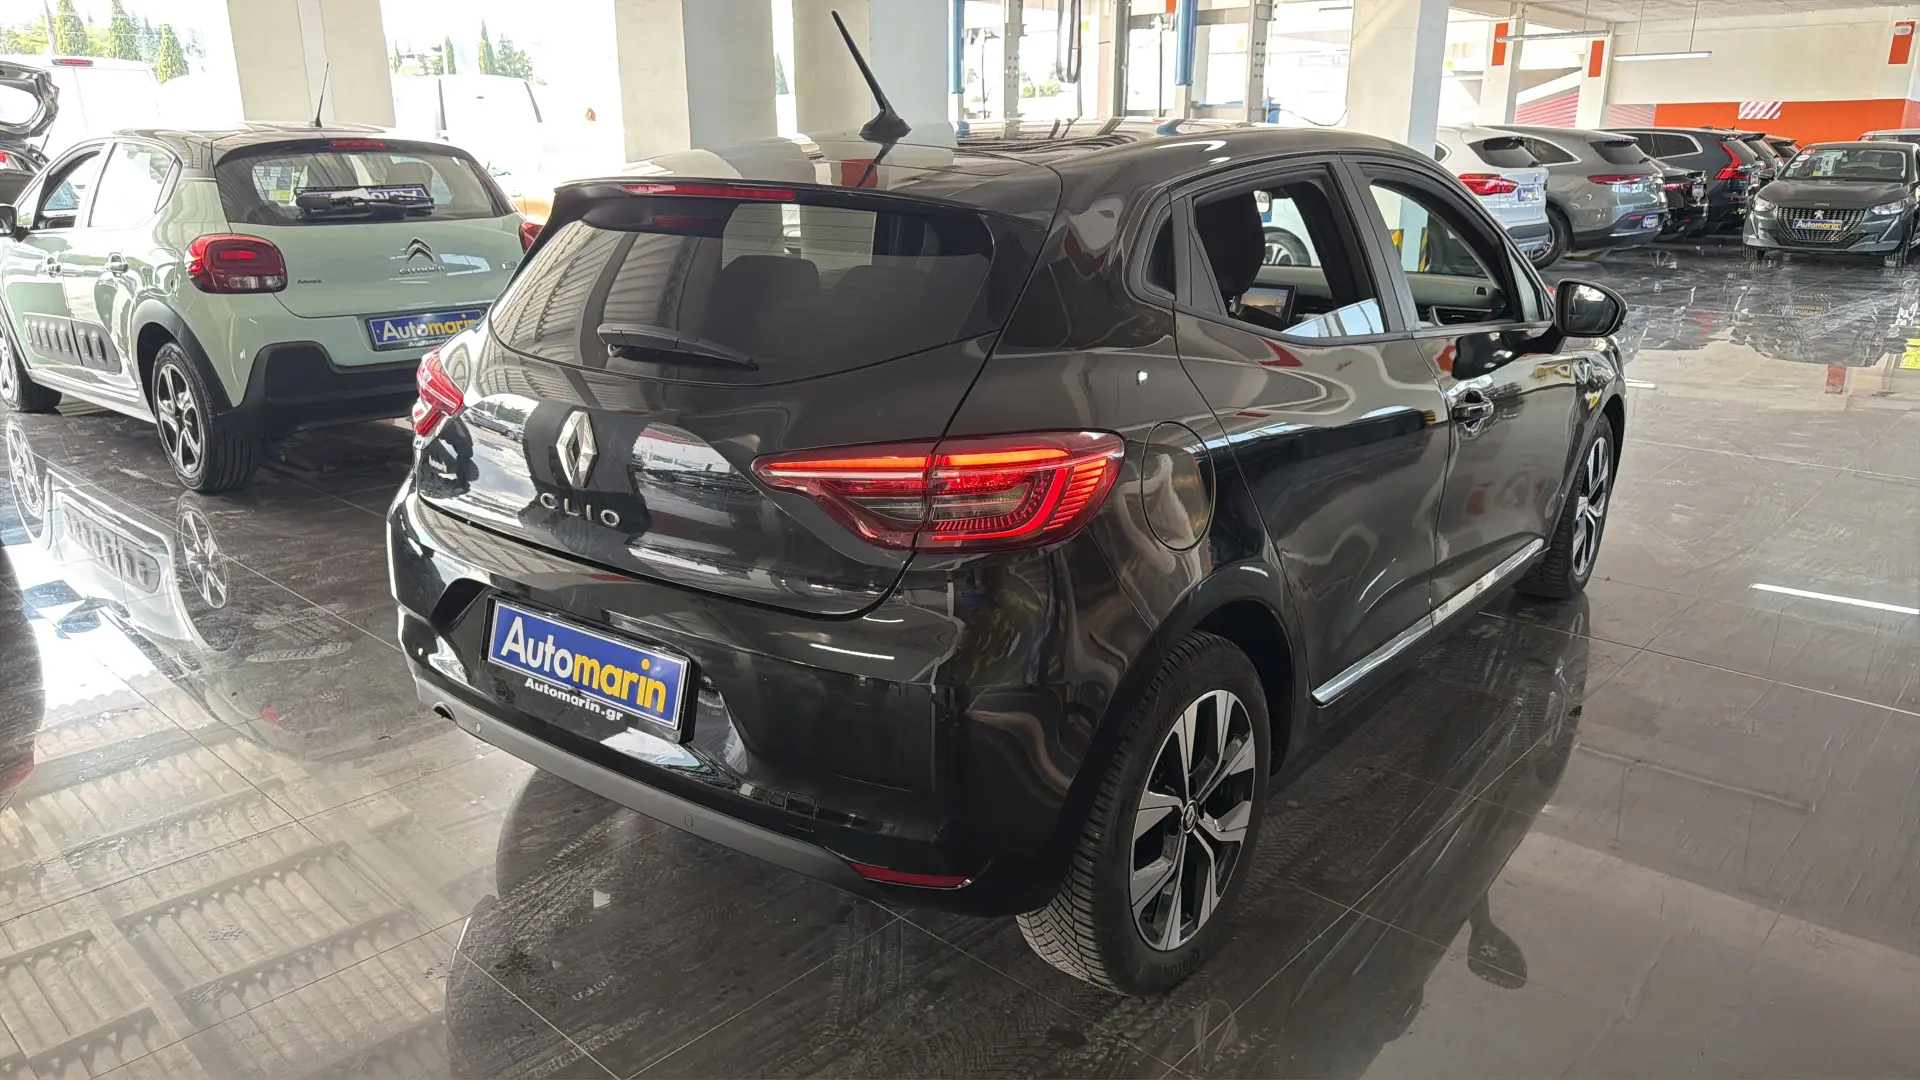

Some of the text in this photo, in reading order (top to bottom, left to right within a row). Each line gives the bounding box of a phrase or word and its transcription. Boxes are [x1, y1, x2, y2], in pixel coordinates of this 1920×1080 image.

[1795, 219, 1839, 229] Automarin
[540, 493, 621, 527] CLIO
[500, 616, 666, 713] Automarin
[524, 677, 624, 721] Automarin.gr
